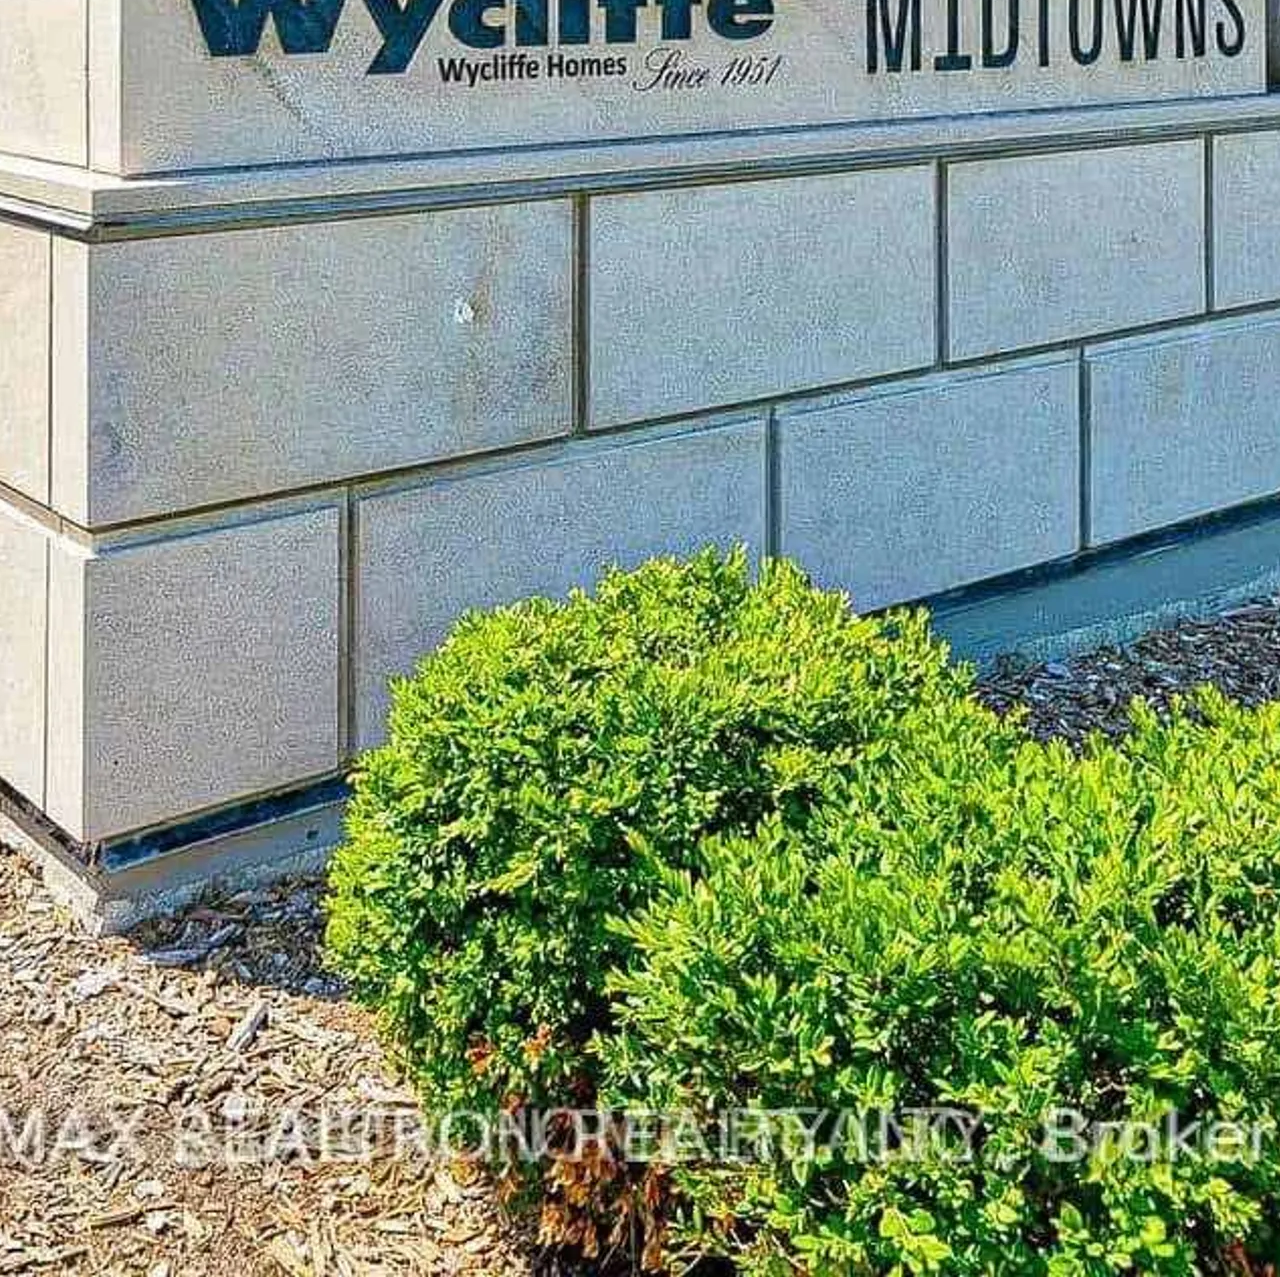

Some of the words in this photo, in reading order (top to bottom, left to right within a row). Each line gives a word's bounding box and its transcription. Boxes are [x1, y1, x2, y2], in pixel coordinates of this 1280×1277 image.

[438, 53, 540, 87] Wycliffe
[546, 53, 628, 79] Homes
[632, 47, 711, 92] Since
[720, 53, 782, 86] 1951
